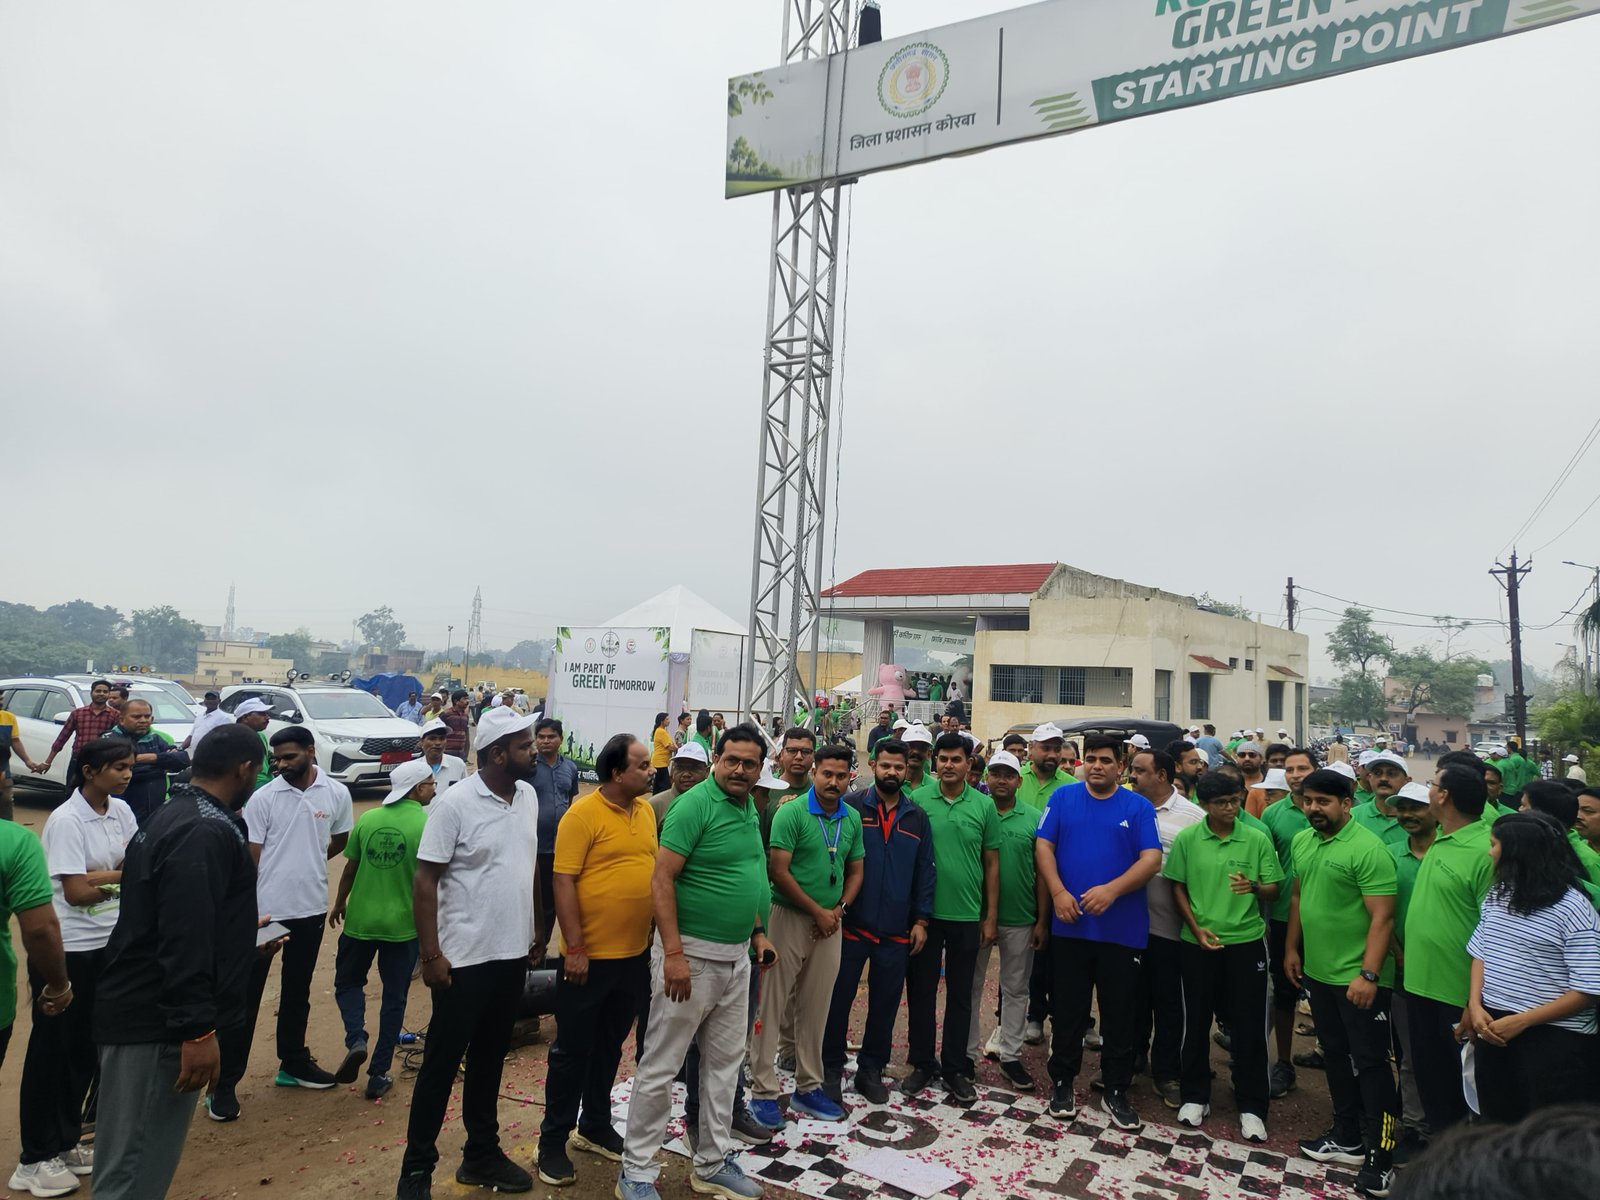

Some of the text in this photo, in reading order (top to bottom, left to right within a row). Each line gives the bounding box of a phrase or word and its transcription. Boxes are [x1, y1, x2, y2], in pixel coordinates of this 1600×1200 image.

[1112, 2, 1482, 110] STARTING POINT
[850, 112, 977, 151] जिला प्रशासन कोरबा
[569, 662, 581, 673] AM
[583, 662, 604, 674] PART
[606, 663, 616, 674] OF
[572, 673, 656, 692] GREEN TOMORROW
